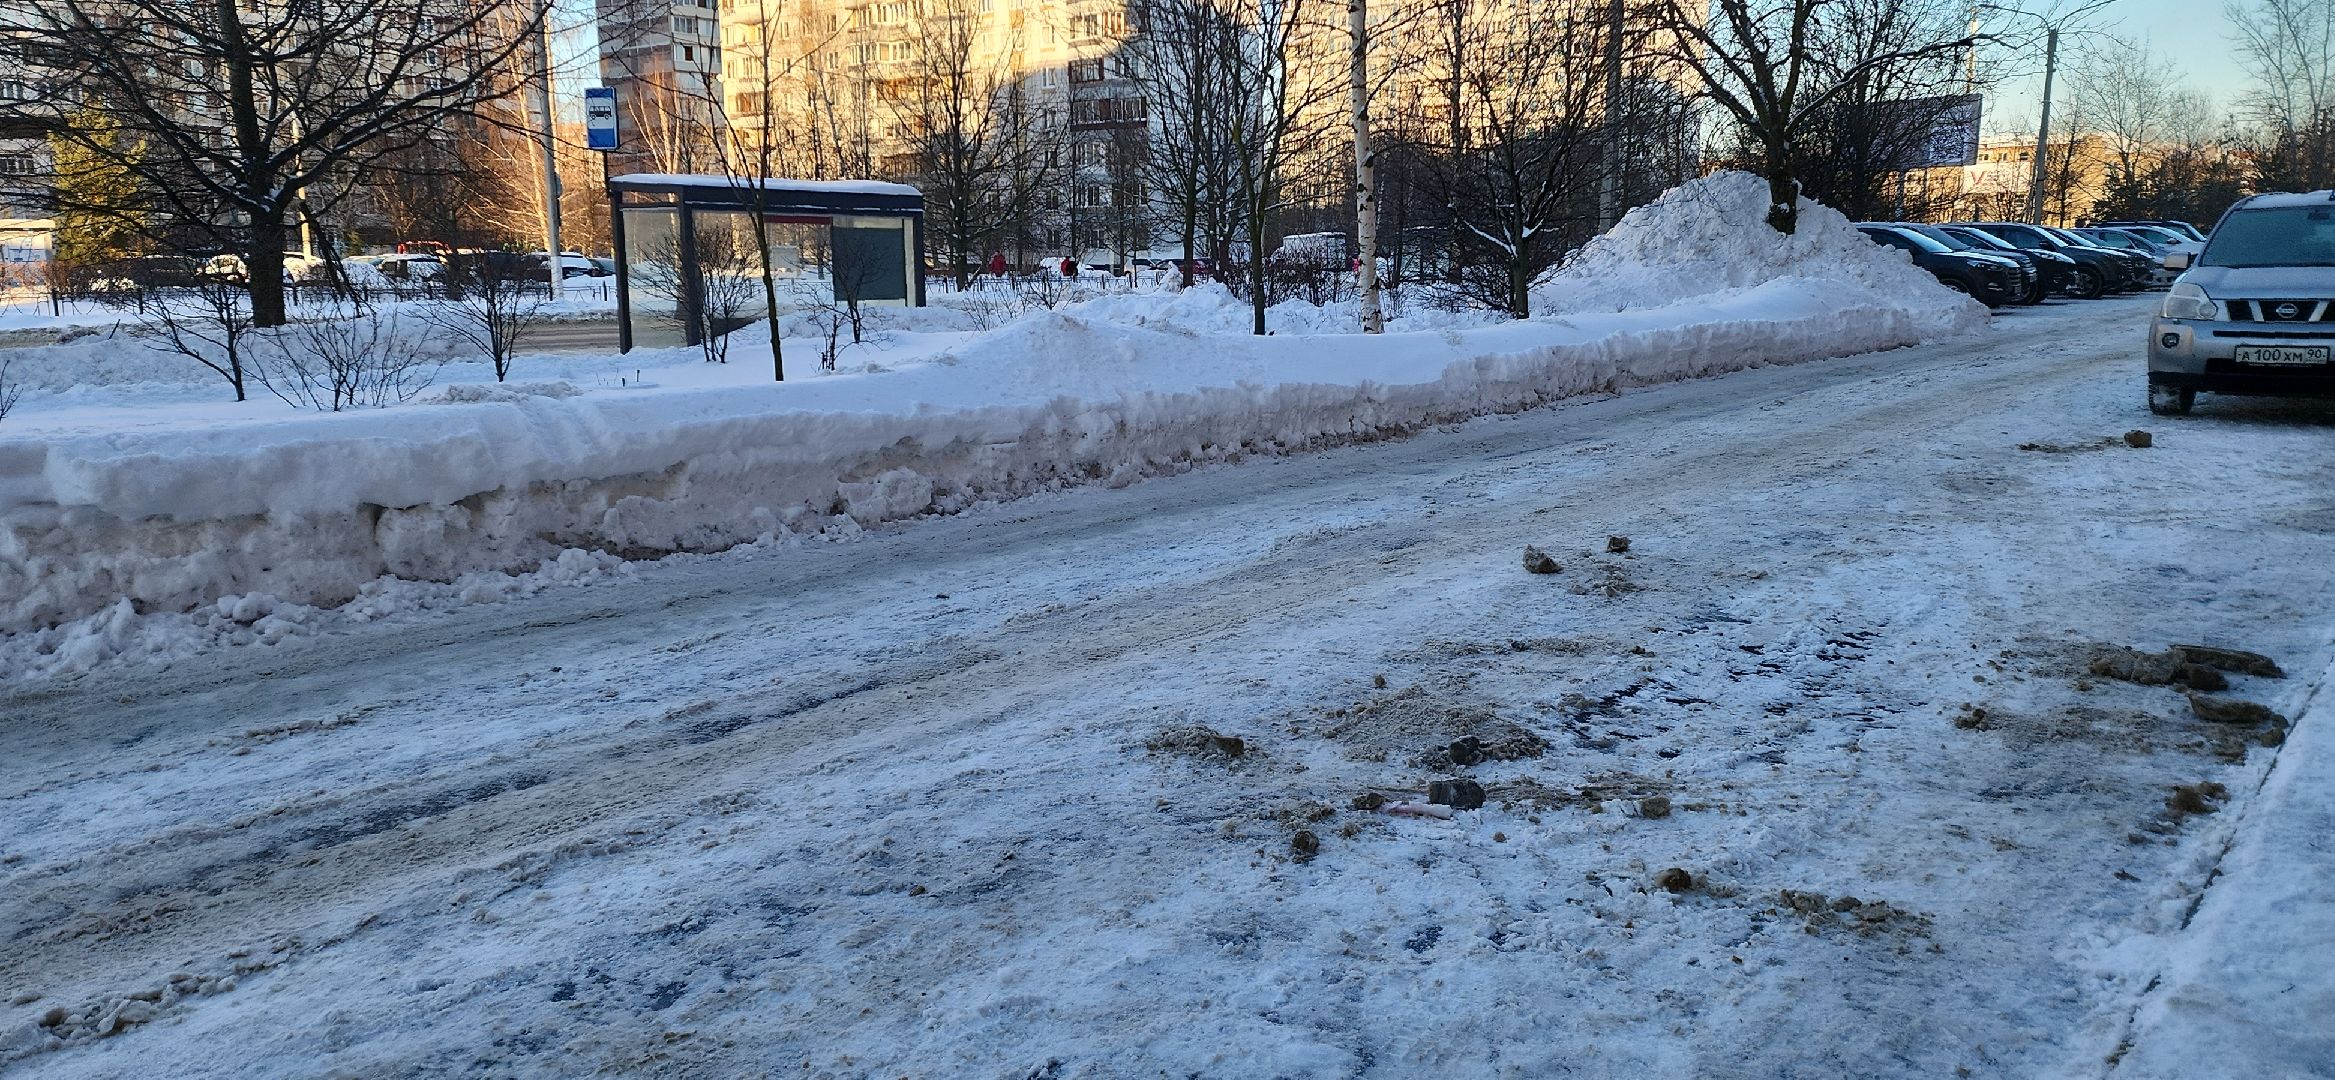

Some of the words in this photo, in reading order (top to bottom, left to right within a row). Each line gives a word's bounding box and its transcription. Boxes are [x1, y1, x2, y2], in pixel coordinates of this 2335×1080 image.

[2254, 349, 2281, 361] 100
[2284, 352, 2303, 362] ХМ
[2307, 349, 2322, 359] 90
